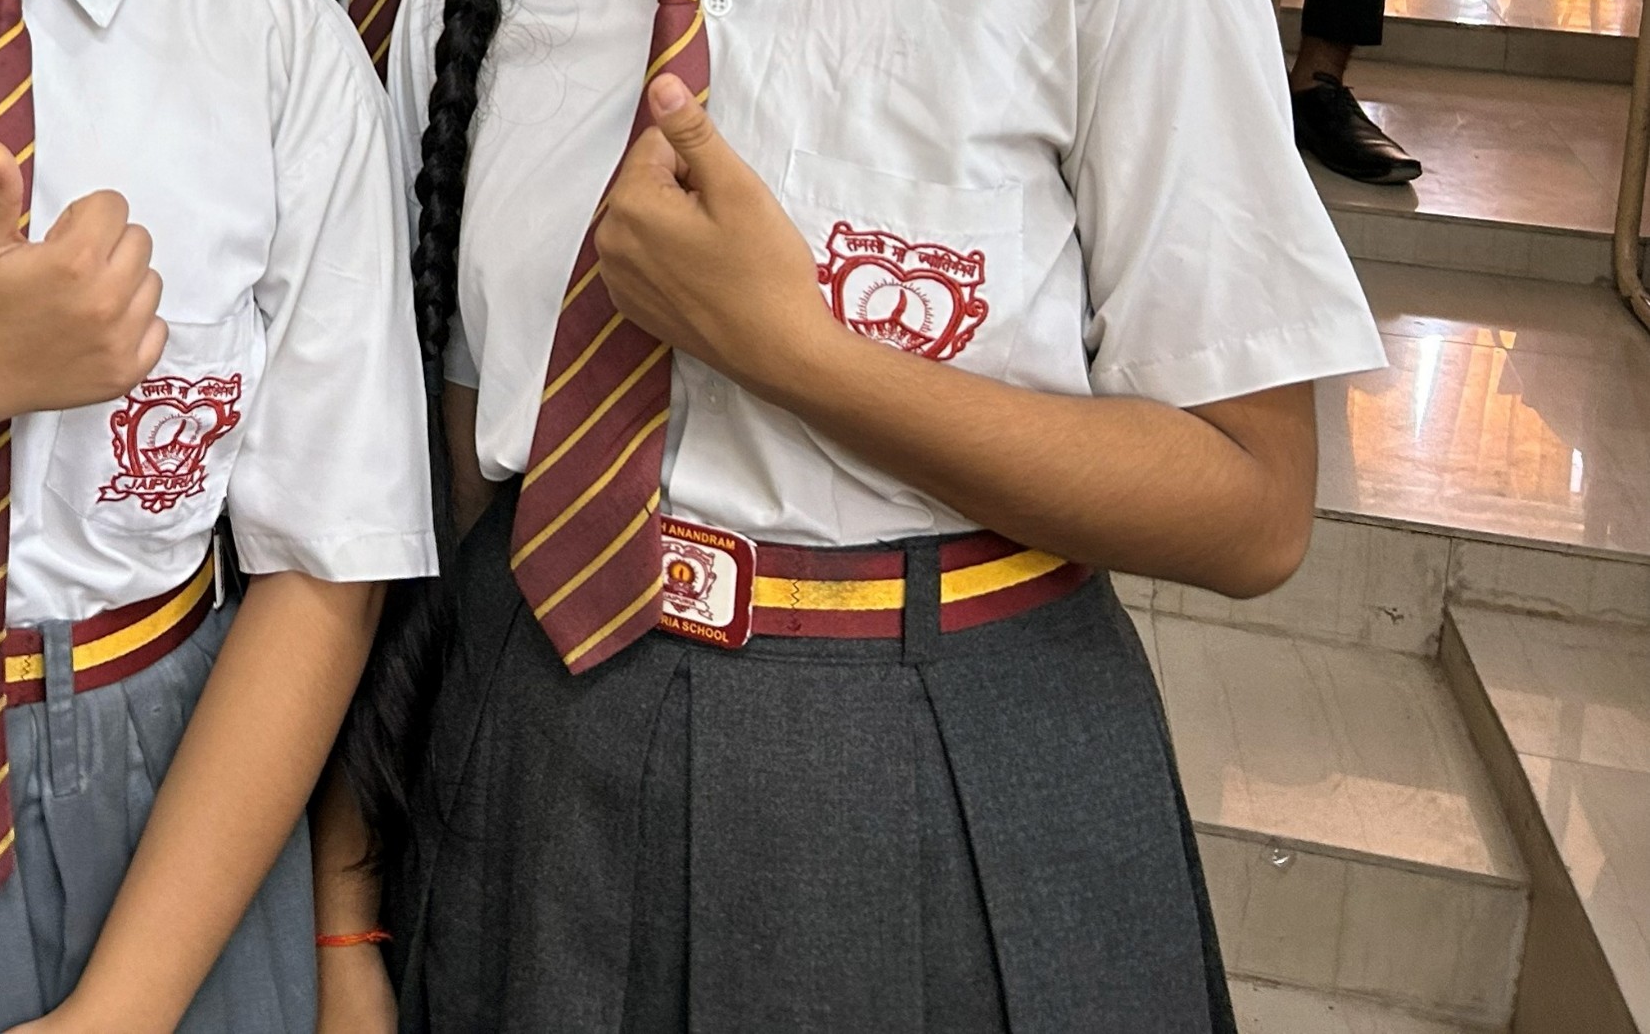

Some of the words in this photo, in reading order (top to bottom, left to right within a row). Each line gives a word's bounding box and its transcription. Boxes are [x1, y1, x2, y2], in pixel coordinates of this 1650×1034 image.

[123, 475, 194, 490] JAIPURIA
[668, 525, 736, 550] ANANDRAM
[681, 621, 729, 643] SCHOOL
